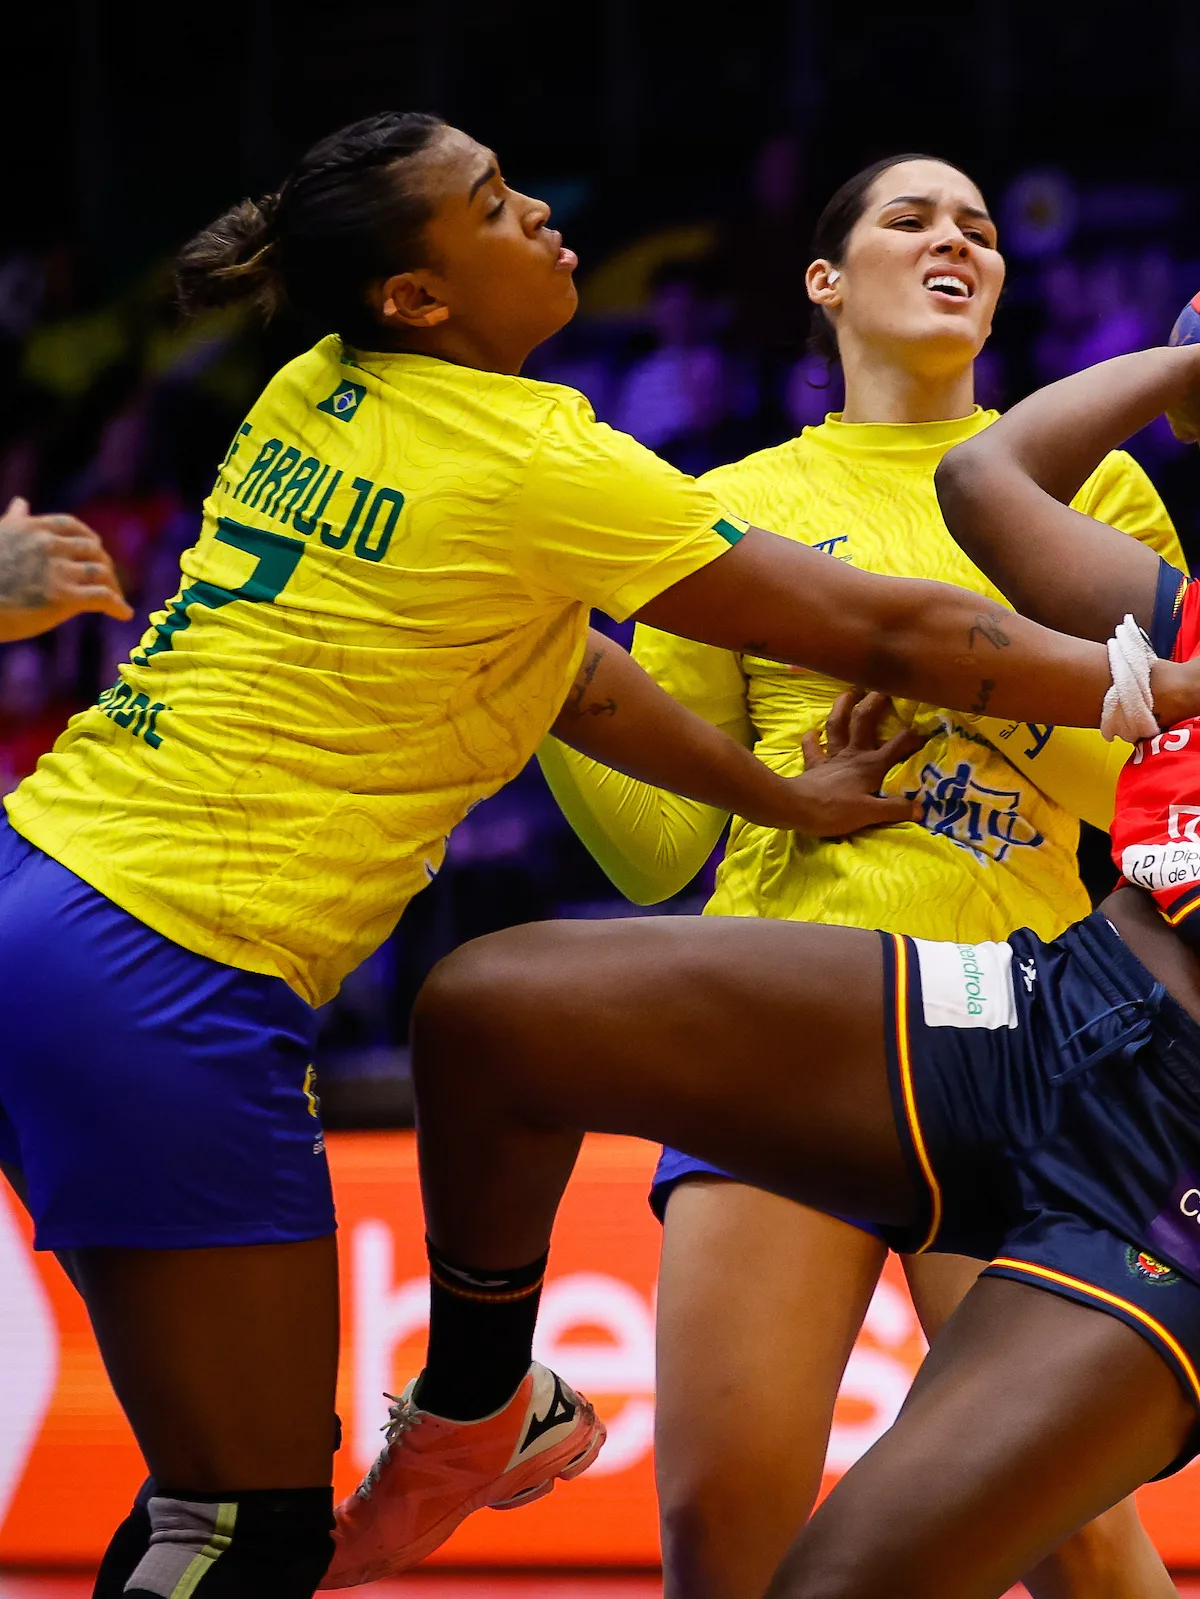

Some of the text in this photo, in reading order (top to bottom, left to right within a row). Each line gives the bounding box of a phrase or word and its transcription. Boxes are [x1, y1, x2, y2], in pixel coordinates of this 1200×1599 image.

[232, 438, 405, 562] ARAUJO
[133, 516, 306, 668] 7
[1168, 867, 1187, 883] de
